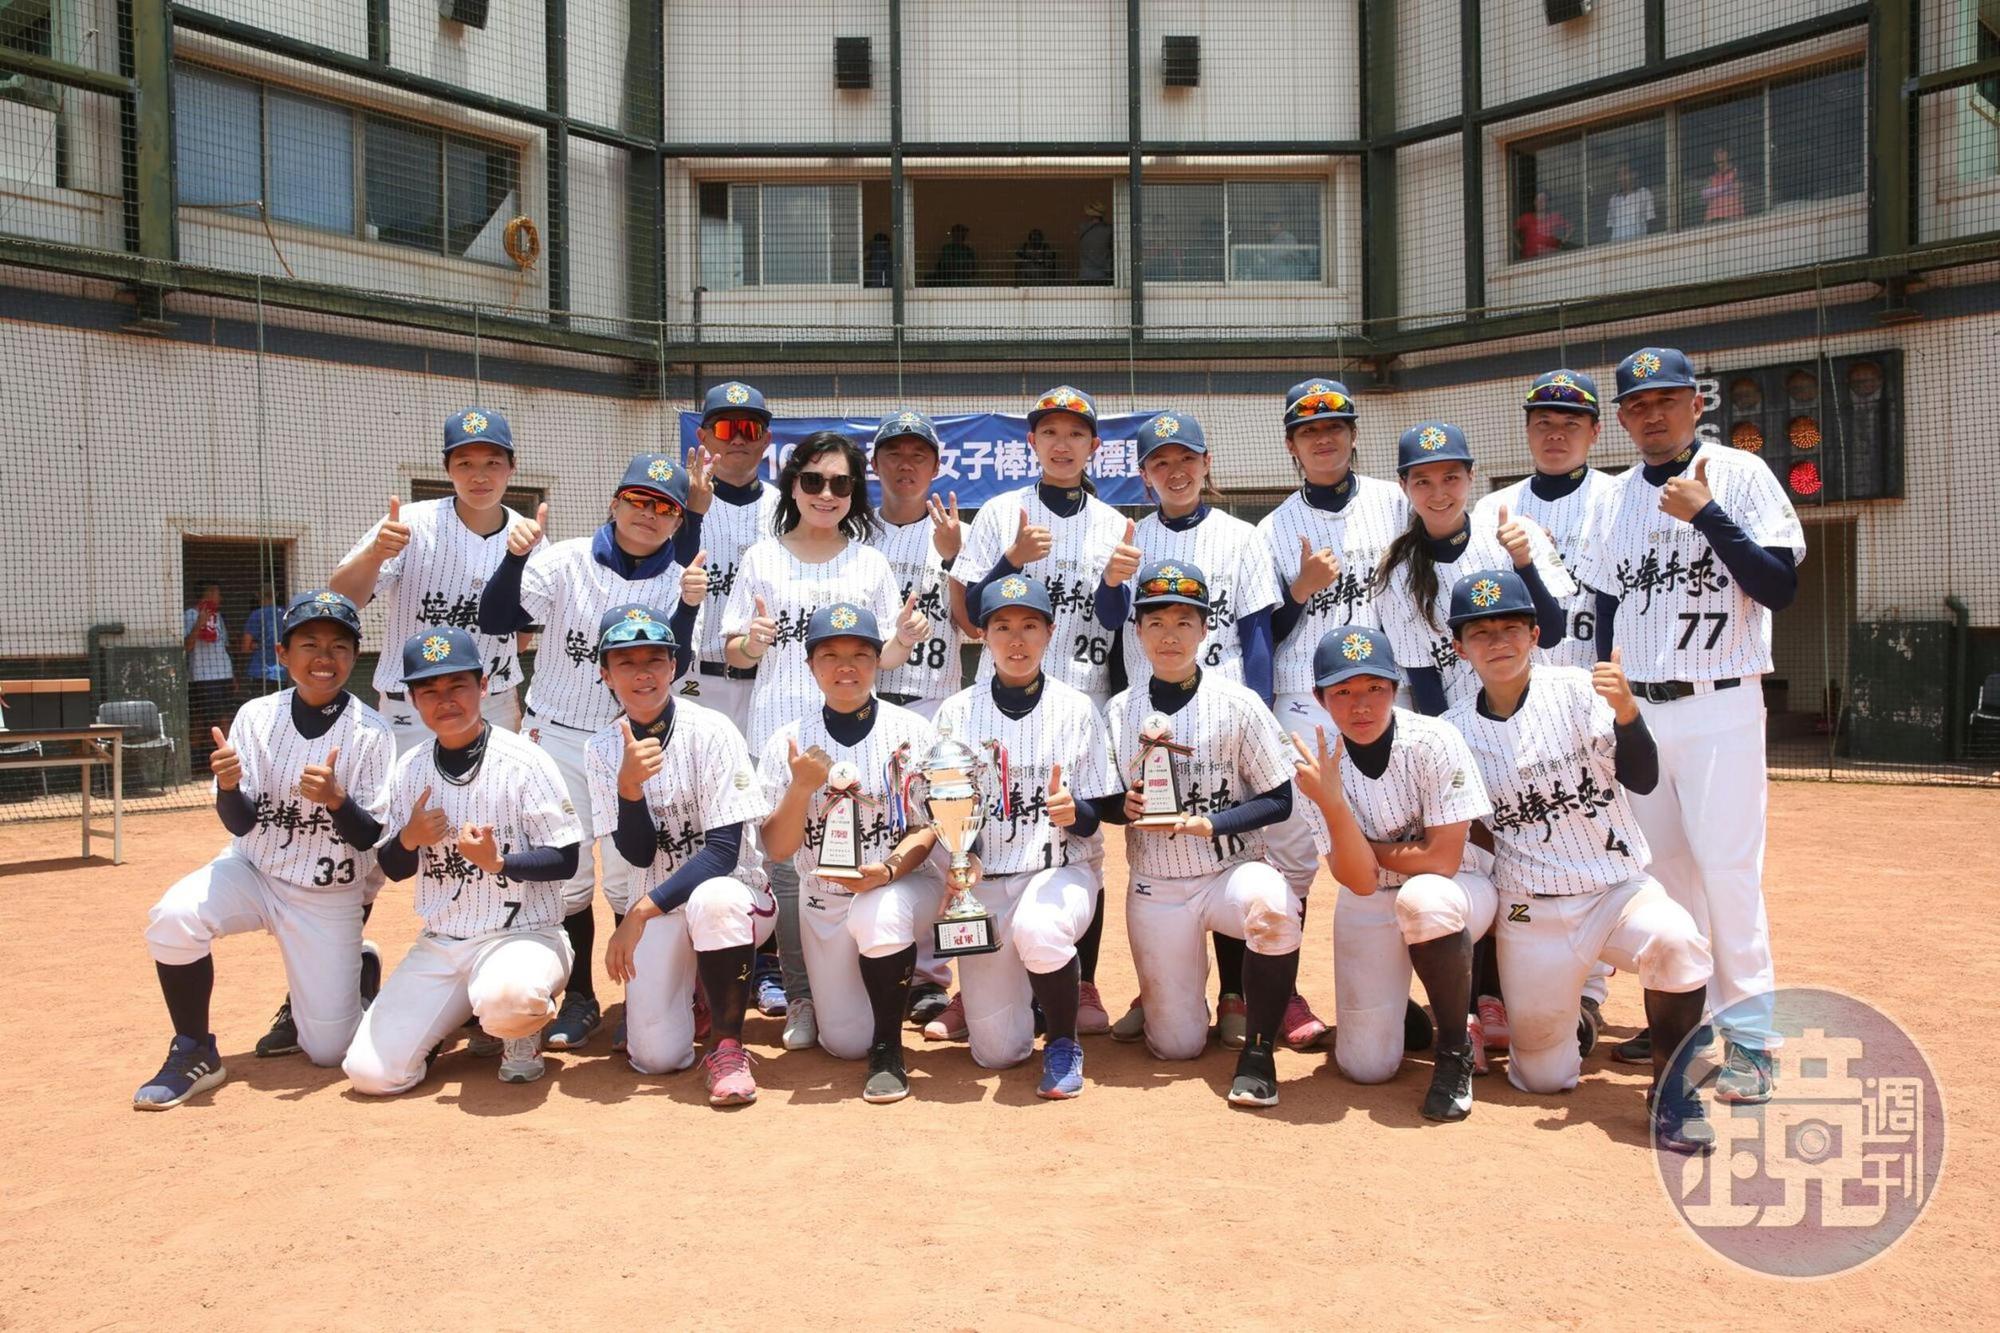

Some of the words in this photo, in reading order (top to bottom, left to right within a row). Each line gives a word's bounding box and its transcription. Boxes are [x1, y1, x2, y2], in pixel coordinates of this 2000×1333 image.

[1696, 379, 1721, 412] B
[1617, 547, 1720, 616] 接棒未來
[1677, 612, 1729, 650] 77
[1073, 634, 1107, 665] 26
[488, 655, 512, 681] 14
[1493, 767, 1609, 843] 接棒未來
[1605, 827, 1630, 857] 4
[314, 856, 356, 887] 33
[503, 901, 521, 928] 7
